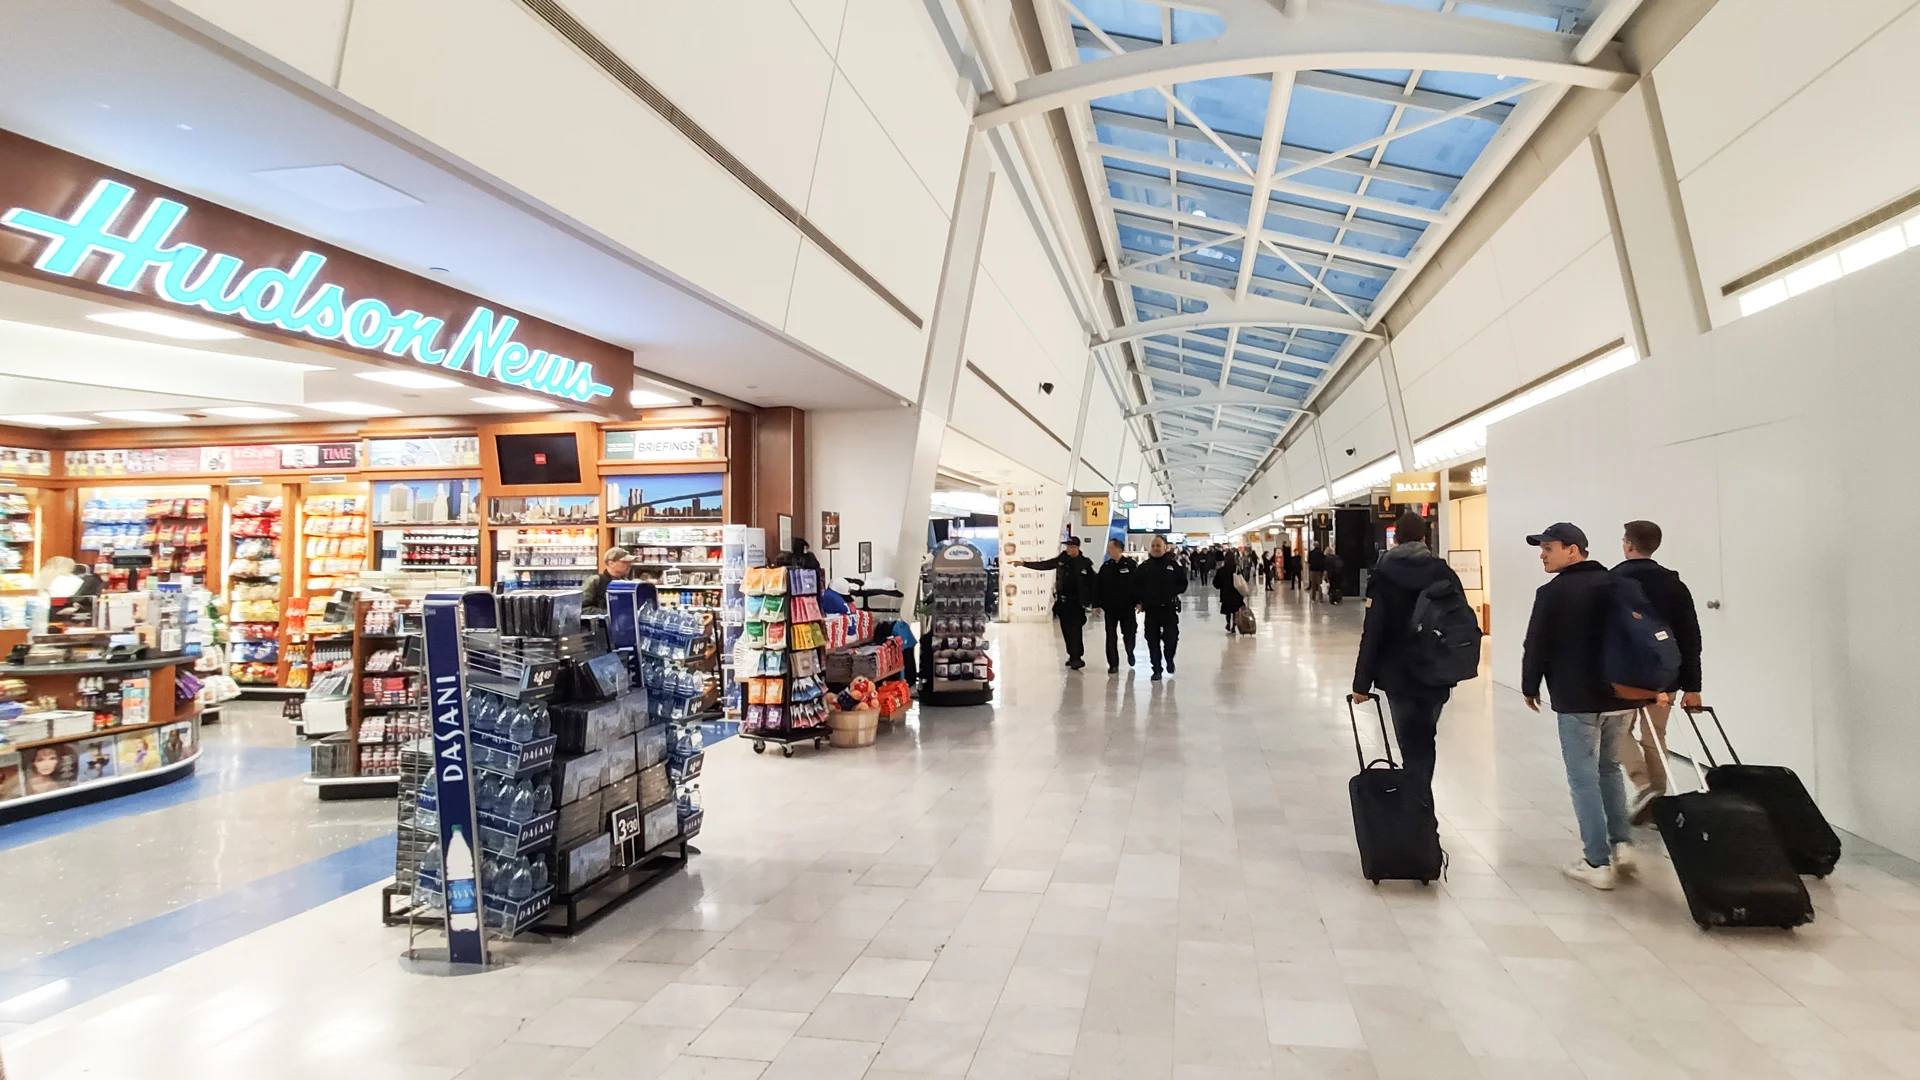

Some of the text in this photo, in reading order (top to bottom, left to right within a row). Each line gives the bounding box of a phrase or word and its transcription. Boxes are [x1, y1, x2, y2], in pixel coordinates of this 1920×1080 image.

[1, 179, 613, 402] Hudson News
[233, 448, 275, 460] InStyle
[321, 447, 353, 461] TIME
[638, 441, 695, 452] BRIEFINGS
[1396, 482, 1436, 492] BALLY
[1092, 508, 1098, 518] 4
[434, 675, 465, 782] DASANI
[522, 744, 553, 762] DASANI
[522, 820, 554, 842] DASANI
[519, 896, 551, 920] DASANI
